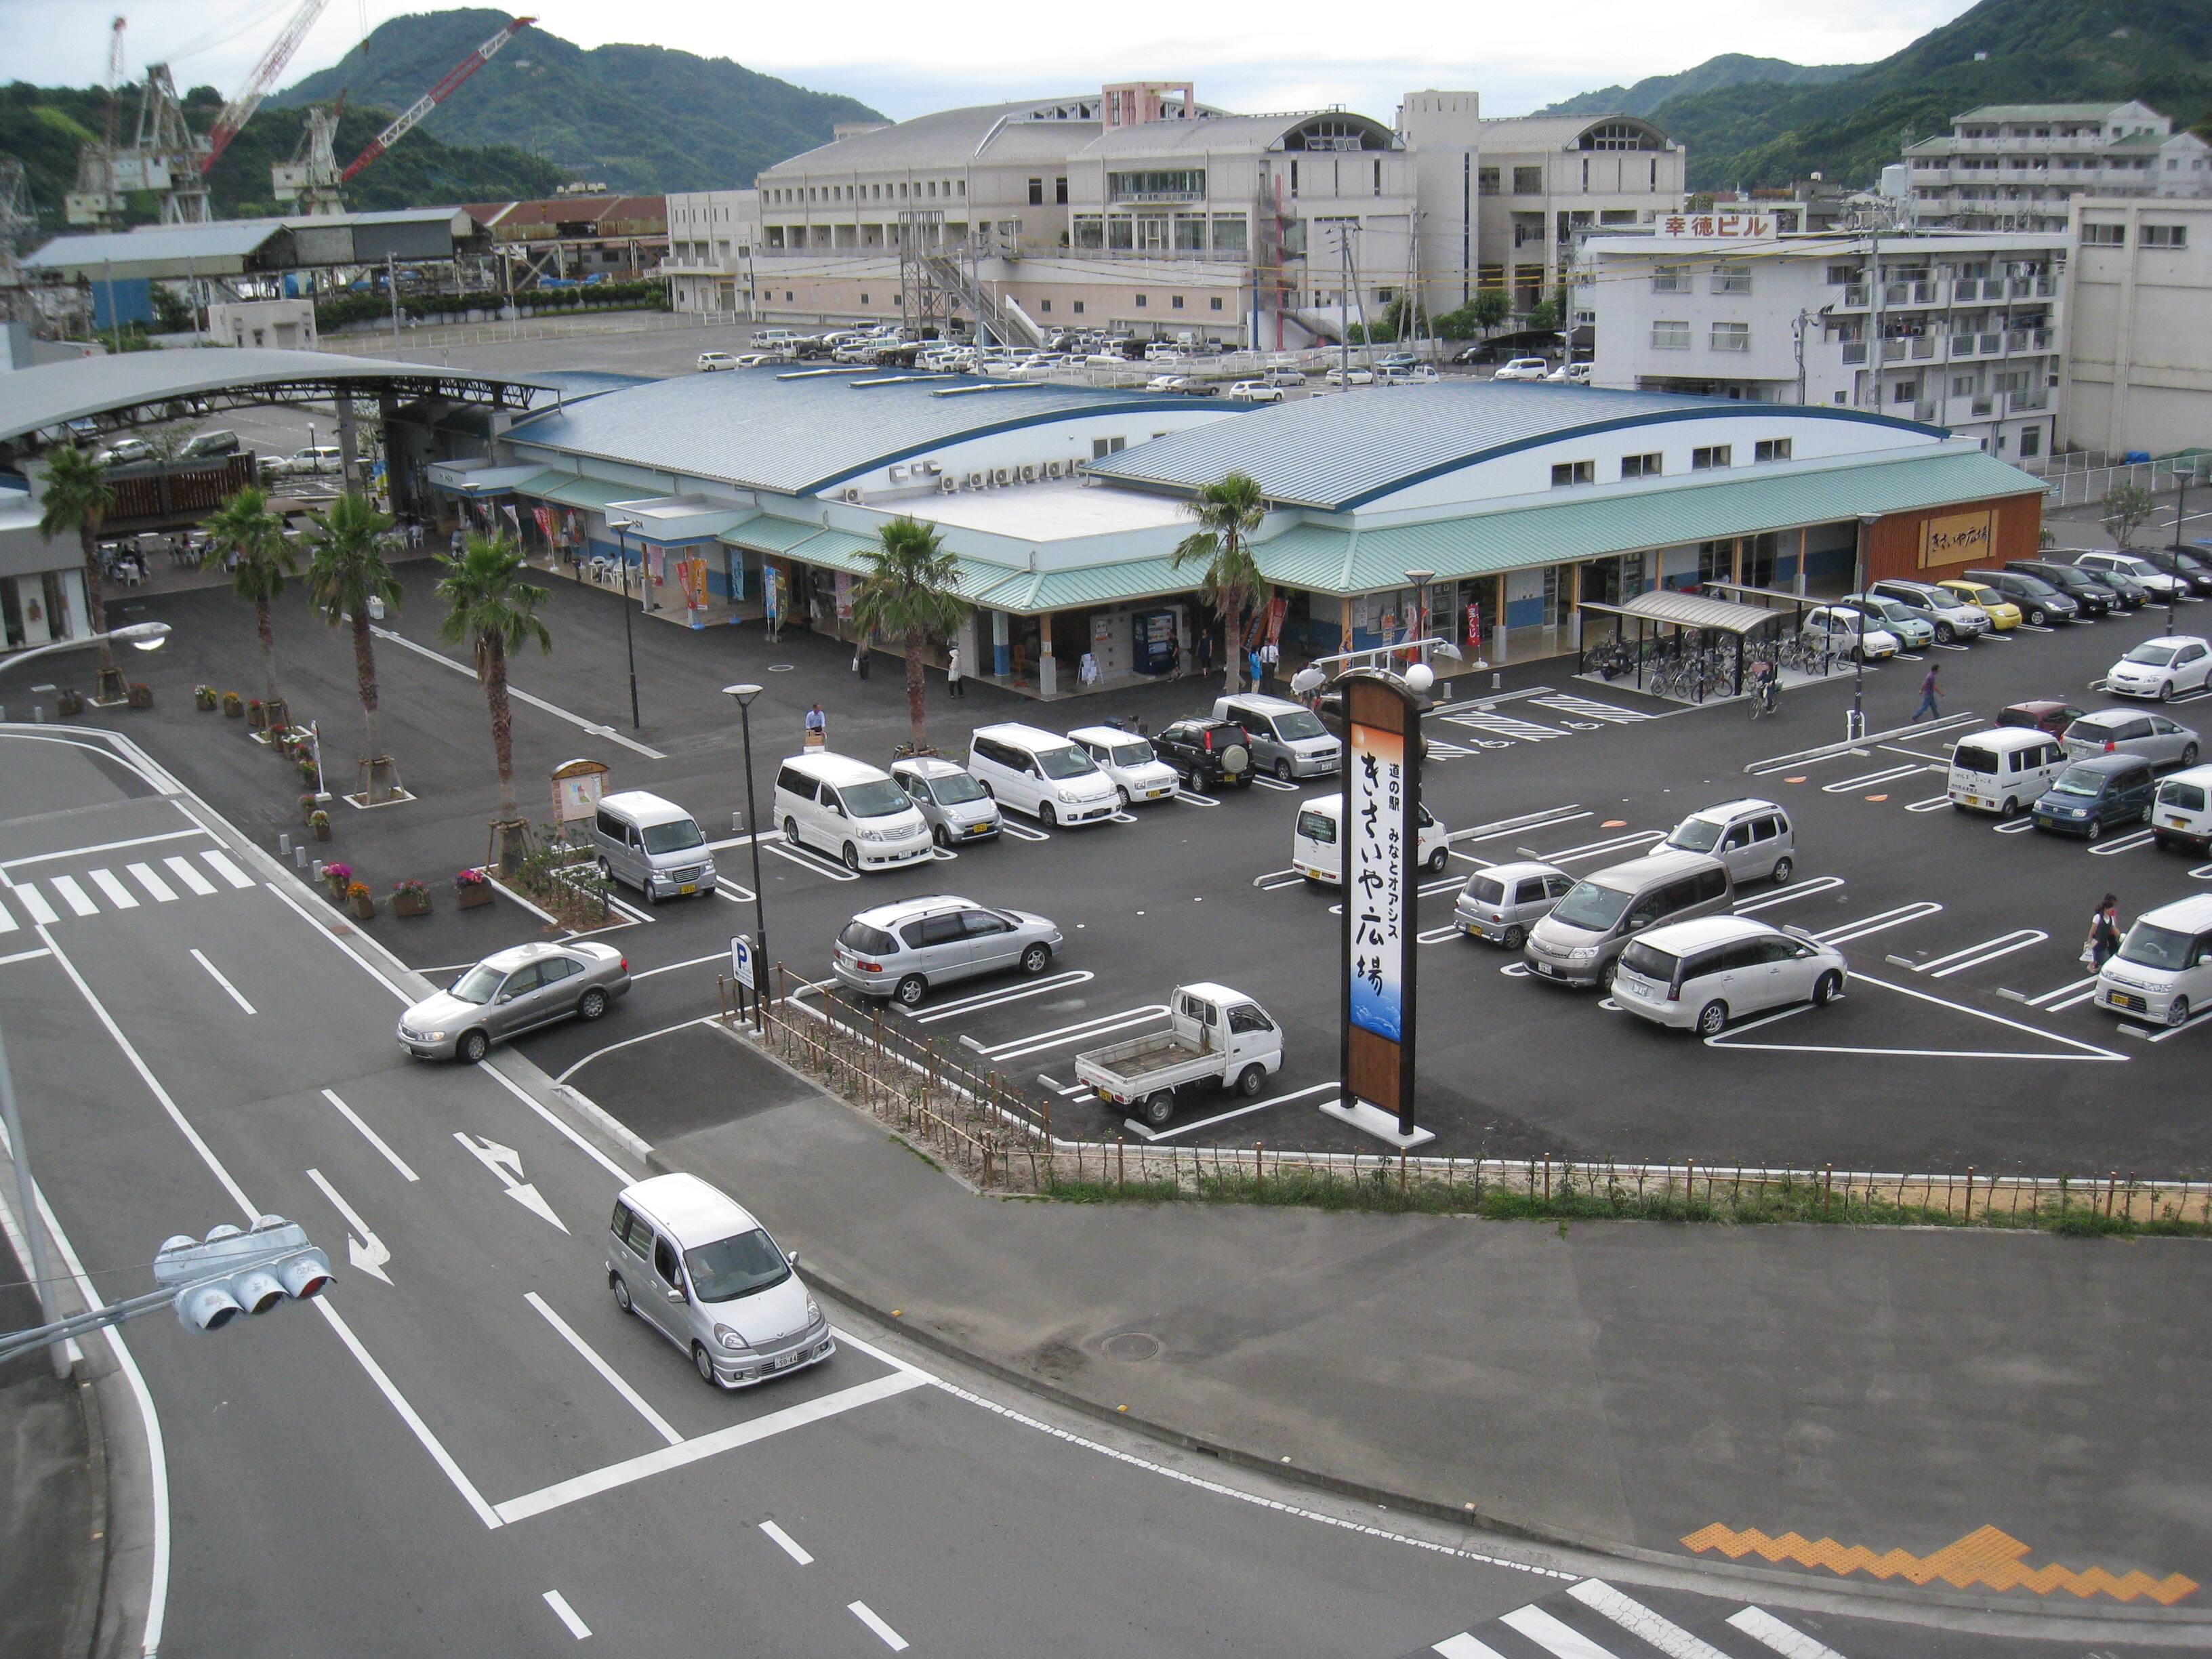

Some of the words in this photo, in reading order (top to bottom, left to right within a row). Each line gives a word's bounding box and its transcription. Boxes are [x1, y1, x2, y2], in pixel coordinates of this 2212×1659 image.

[1665, 215, 1768, 237] 幸徳ビル
[1468, 607, 1476, 638] 宝くじ
[1389, 763, 1399, 811] 道の駅
[1355, 751, 1384, 996] きさいや広場
[1388, 827, 1399, 939] みなとオアシス
[737, 943, 747, 969] P
